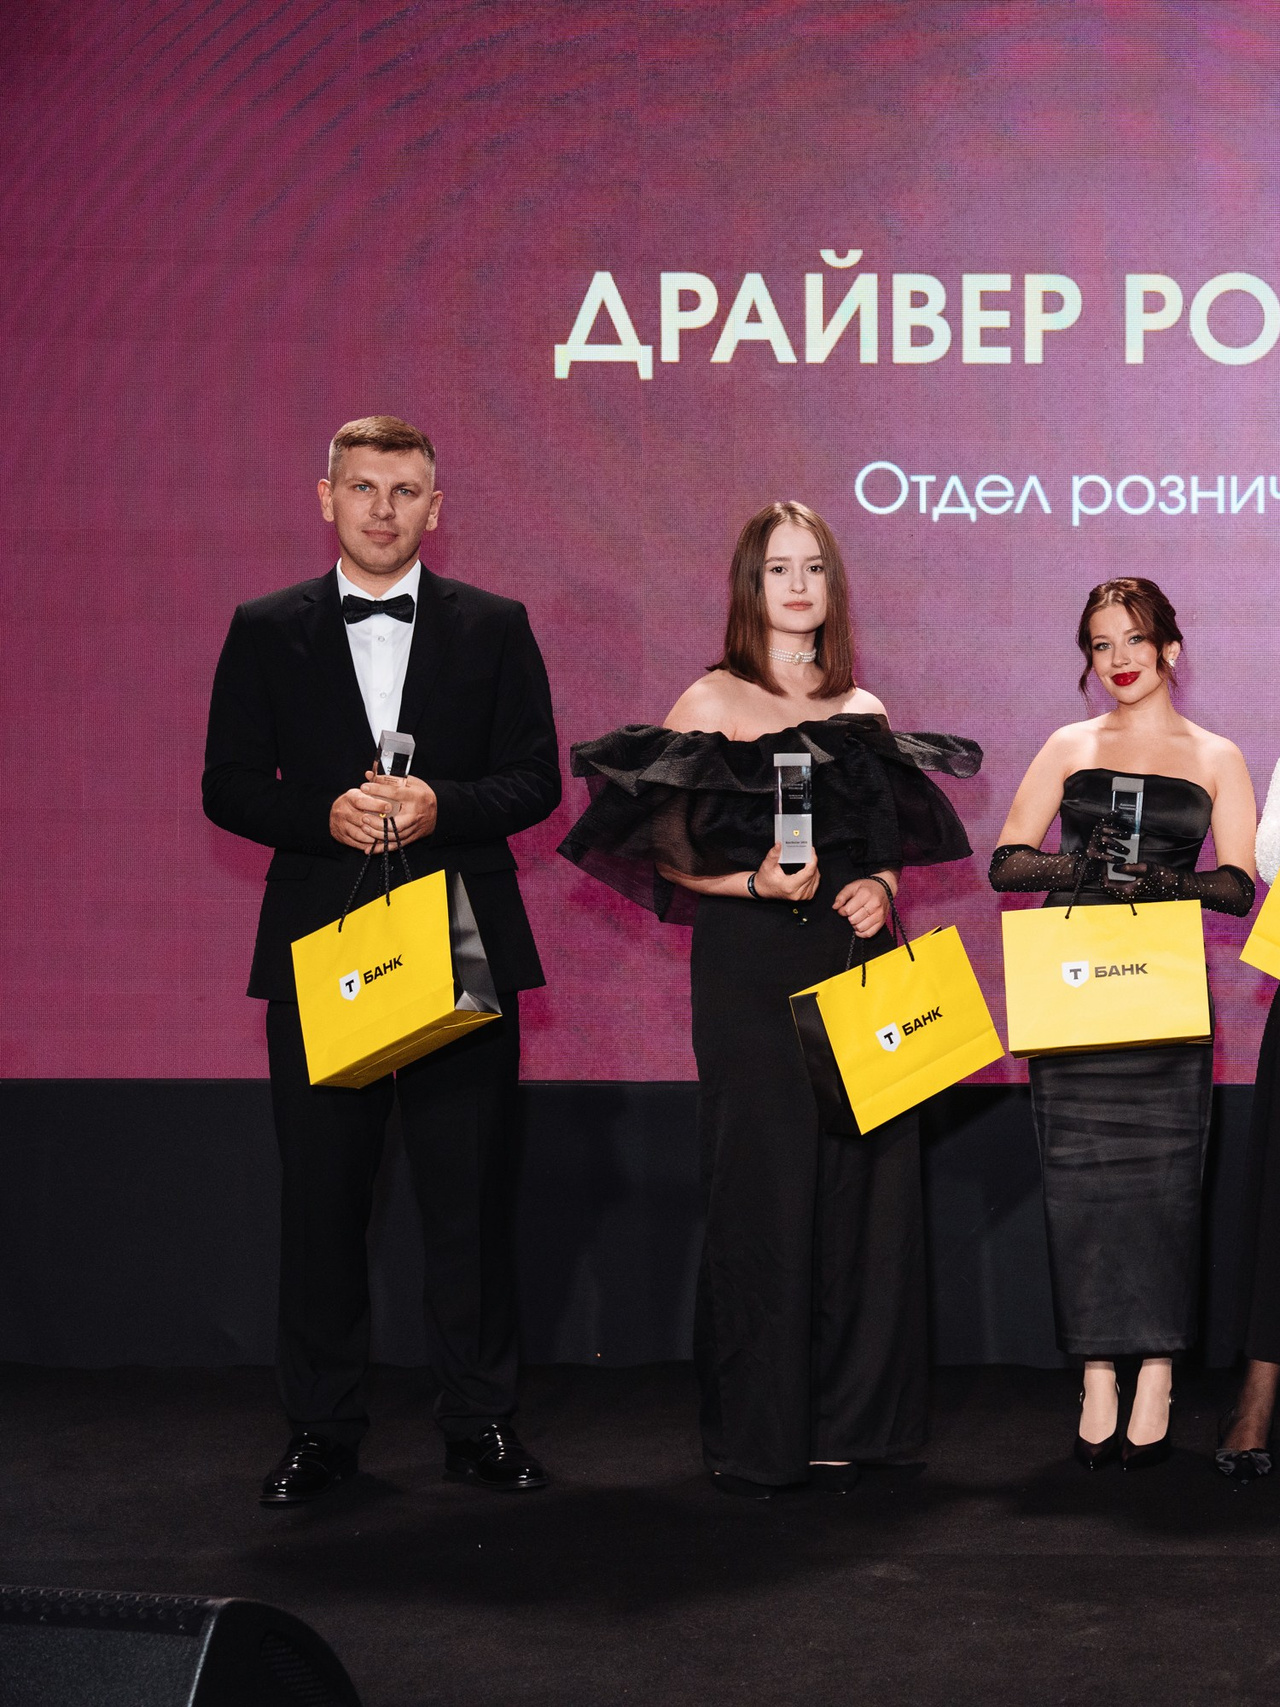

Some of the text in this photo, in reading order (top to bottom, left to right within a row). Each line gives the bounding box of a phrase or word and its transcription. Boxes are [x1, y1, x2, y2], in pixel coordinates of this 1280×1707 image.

[554, 249, 1082, 380] ДРАЙВЕР
[854, 461, 1052, 522] Отдел
[345, 954, 404, 993] Т БАНК
[1069, 962, 1149, 980] Т БАНК
[883, 1006, 943, 1046] Т БАНК
